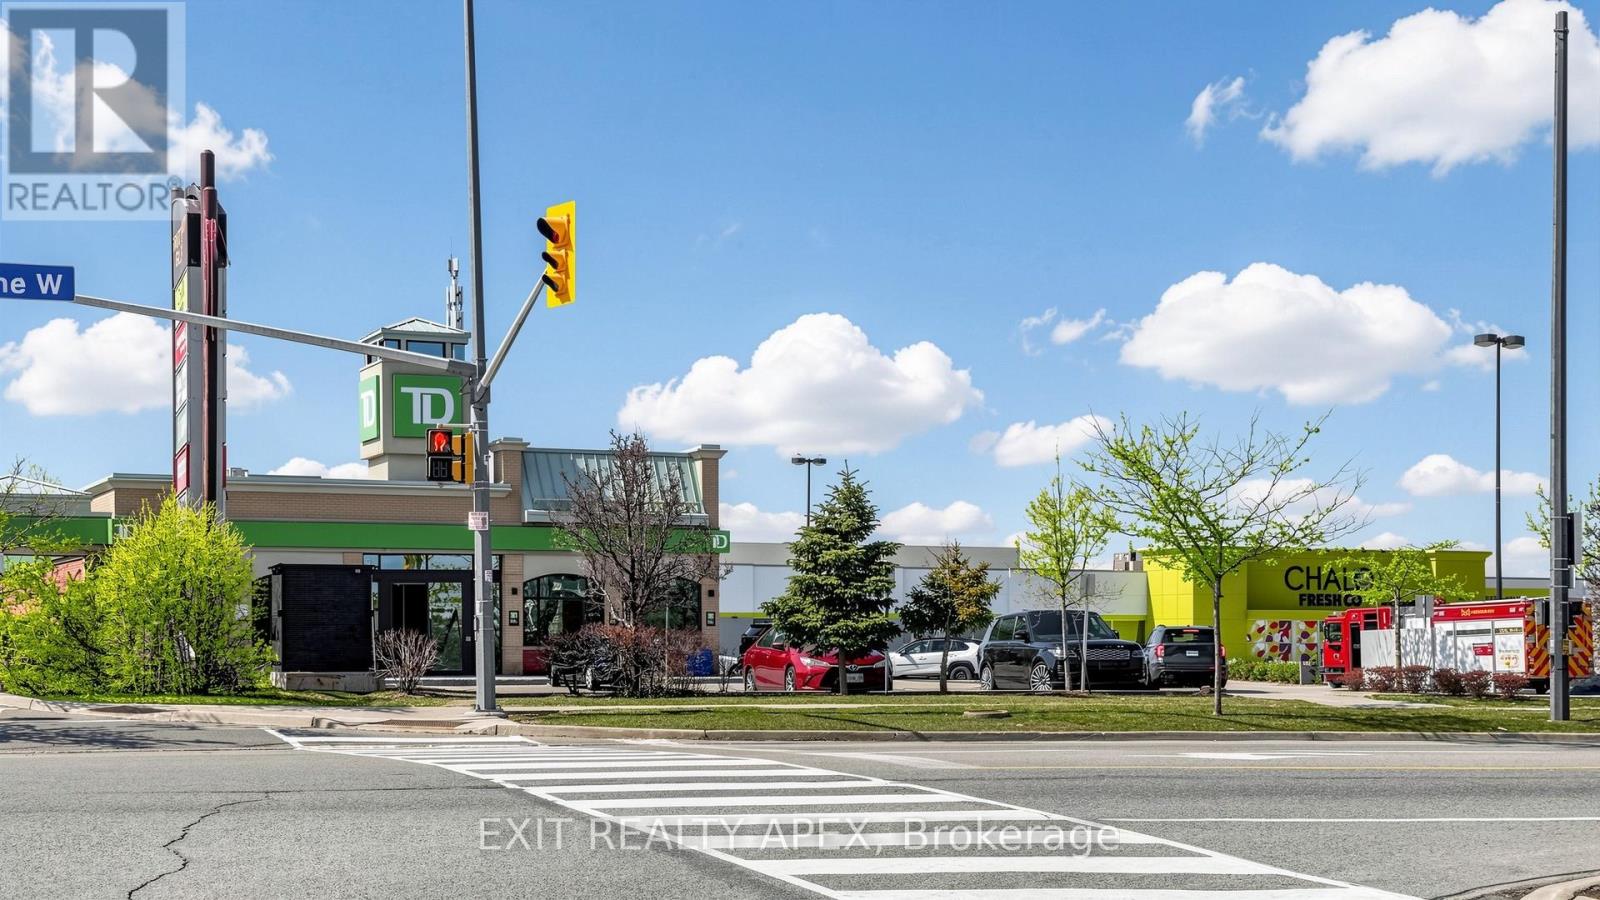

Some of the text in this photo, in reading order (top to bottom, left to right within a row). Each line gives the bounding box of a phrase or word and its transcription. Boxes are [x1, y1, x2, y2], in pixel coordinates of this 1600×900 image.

[36, 273, 63, 295] W
[361, 389, 376, 428] TD
[400, 386, 455, 425] TD
